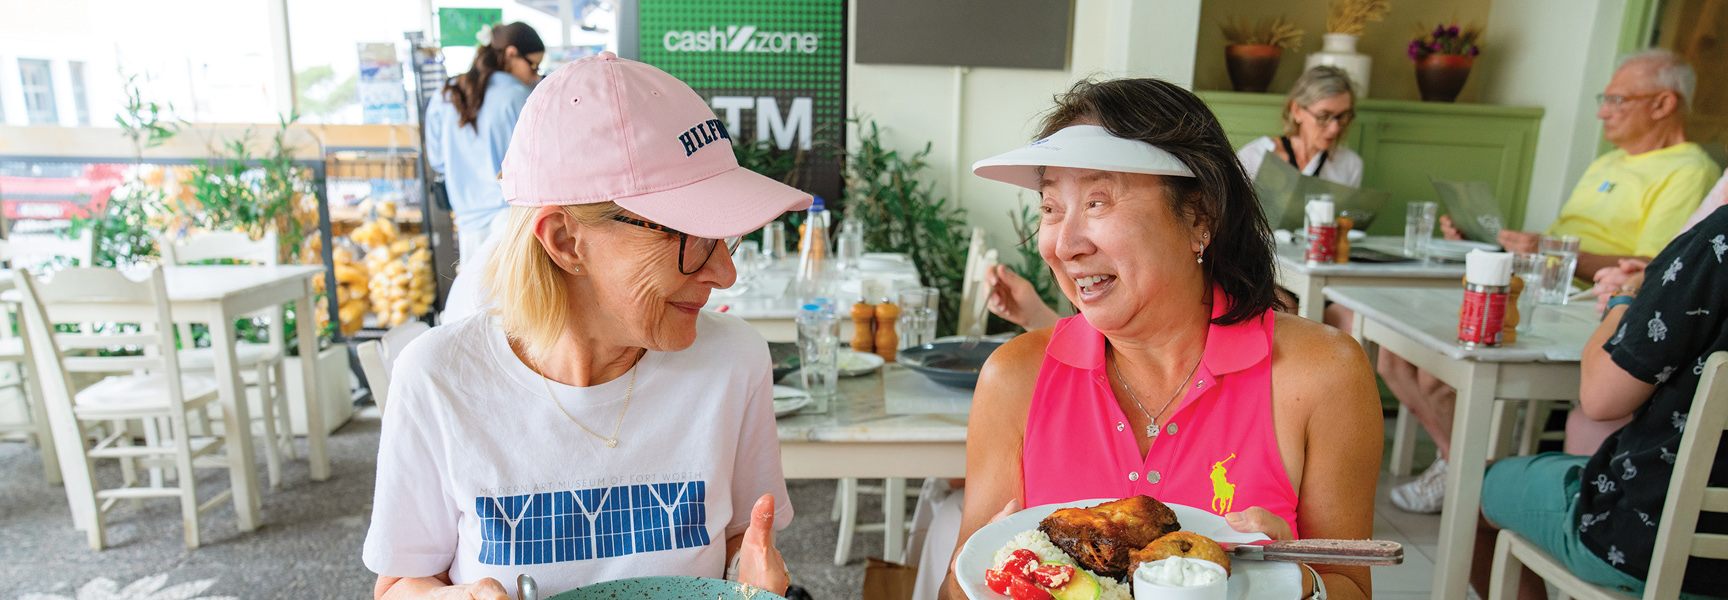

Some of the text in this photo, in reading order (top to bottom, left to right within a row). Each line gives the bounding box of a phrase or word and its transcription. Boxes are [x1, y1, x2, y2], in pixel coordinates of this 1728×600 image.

[711, 96, 813, 150] TM
[480, 471, 702, 496] MODERN ART MUSEUM OF FORT WORTH
